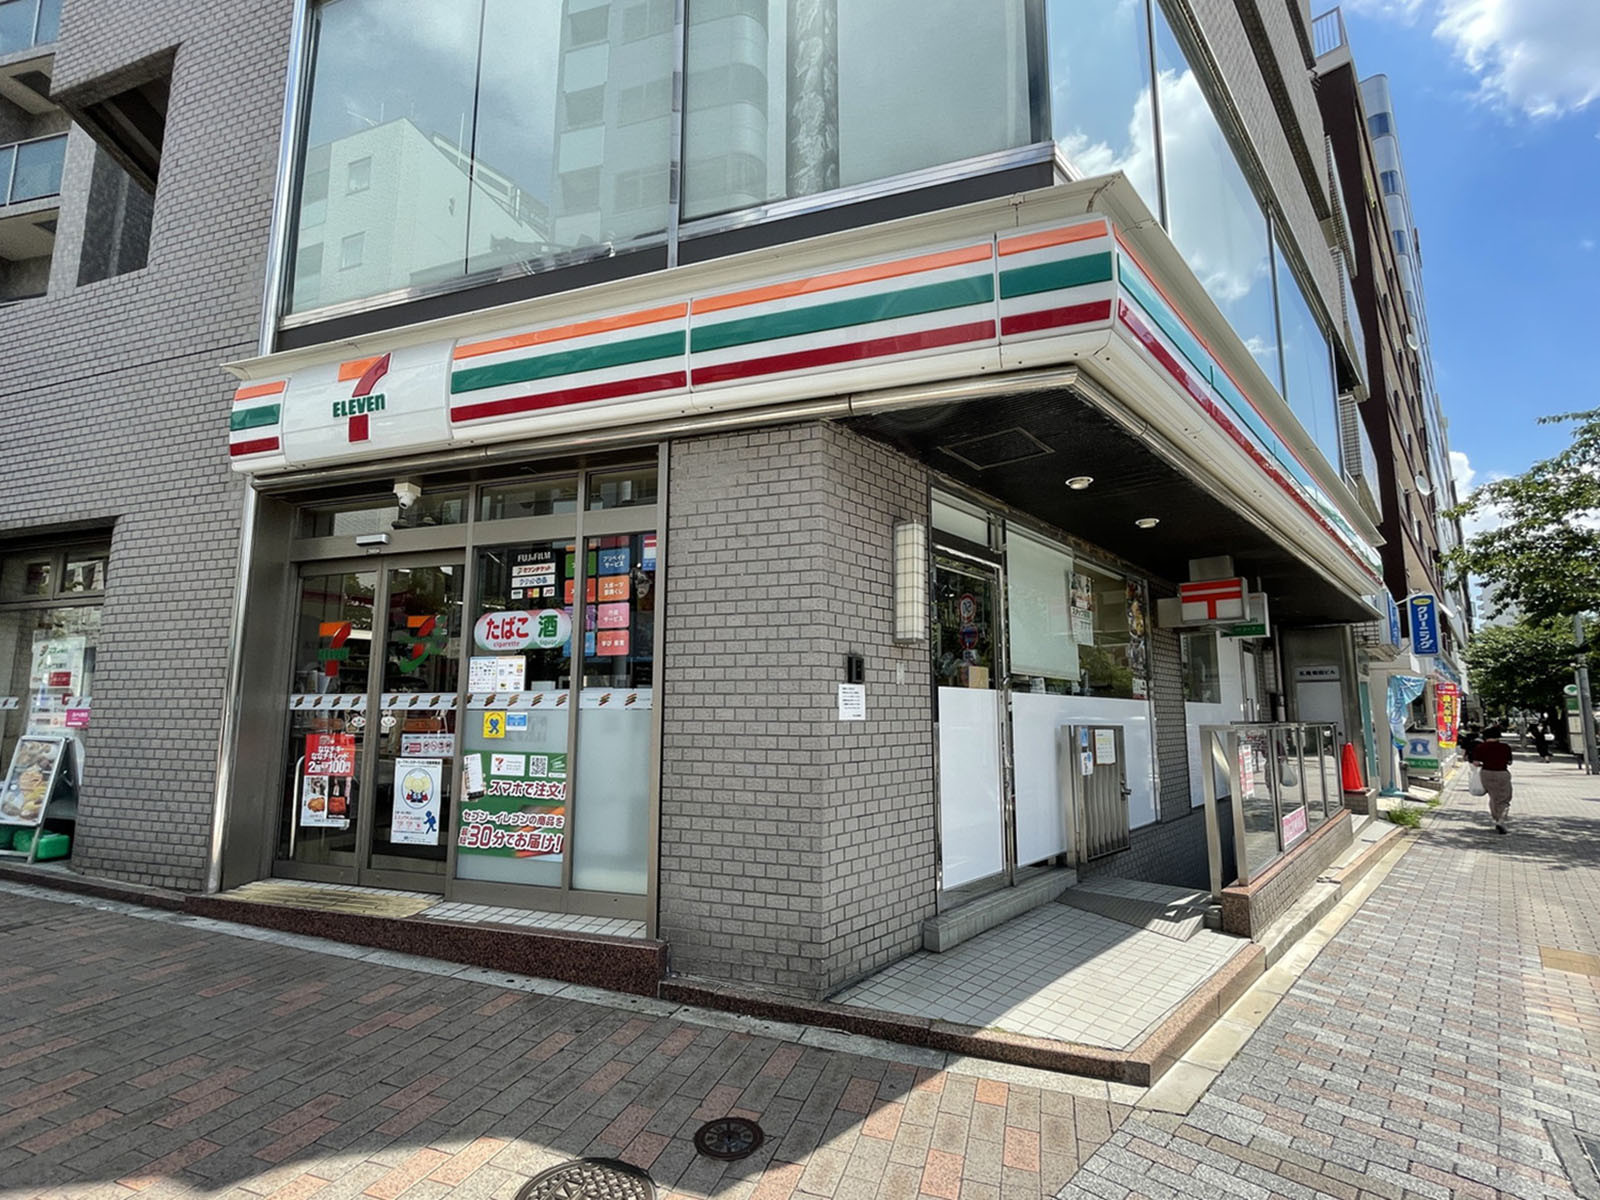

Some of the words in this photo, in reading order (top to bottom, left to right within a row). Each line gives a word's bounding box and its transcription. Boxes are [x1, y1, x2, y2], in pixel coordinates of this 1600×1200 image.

[517, 551, 551, 562] FUJIFILM
[486, 616, 529, 640] たばこ
[538, 614, 558, 637] 酒
[1417, 606, 1434, 649] クリーニング
